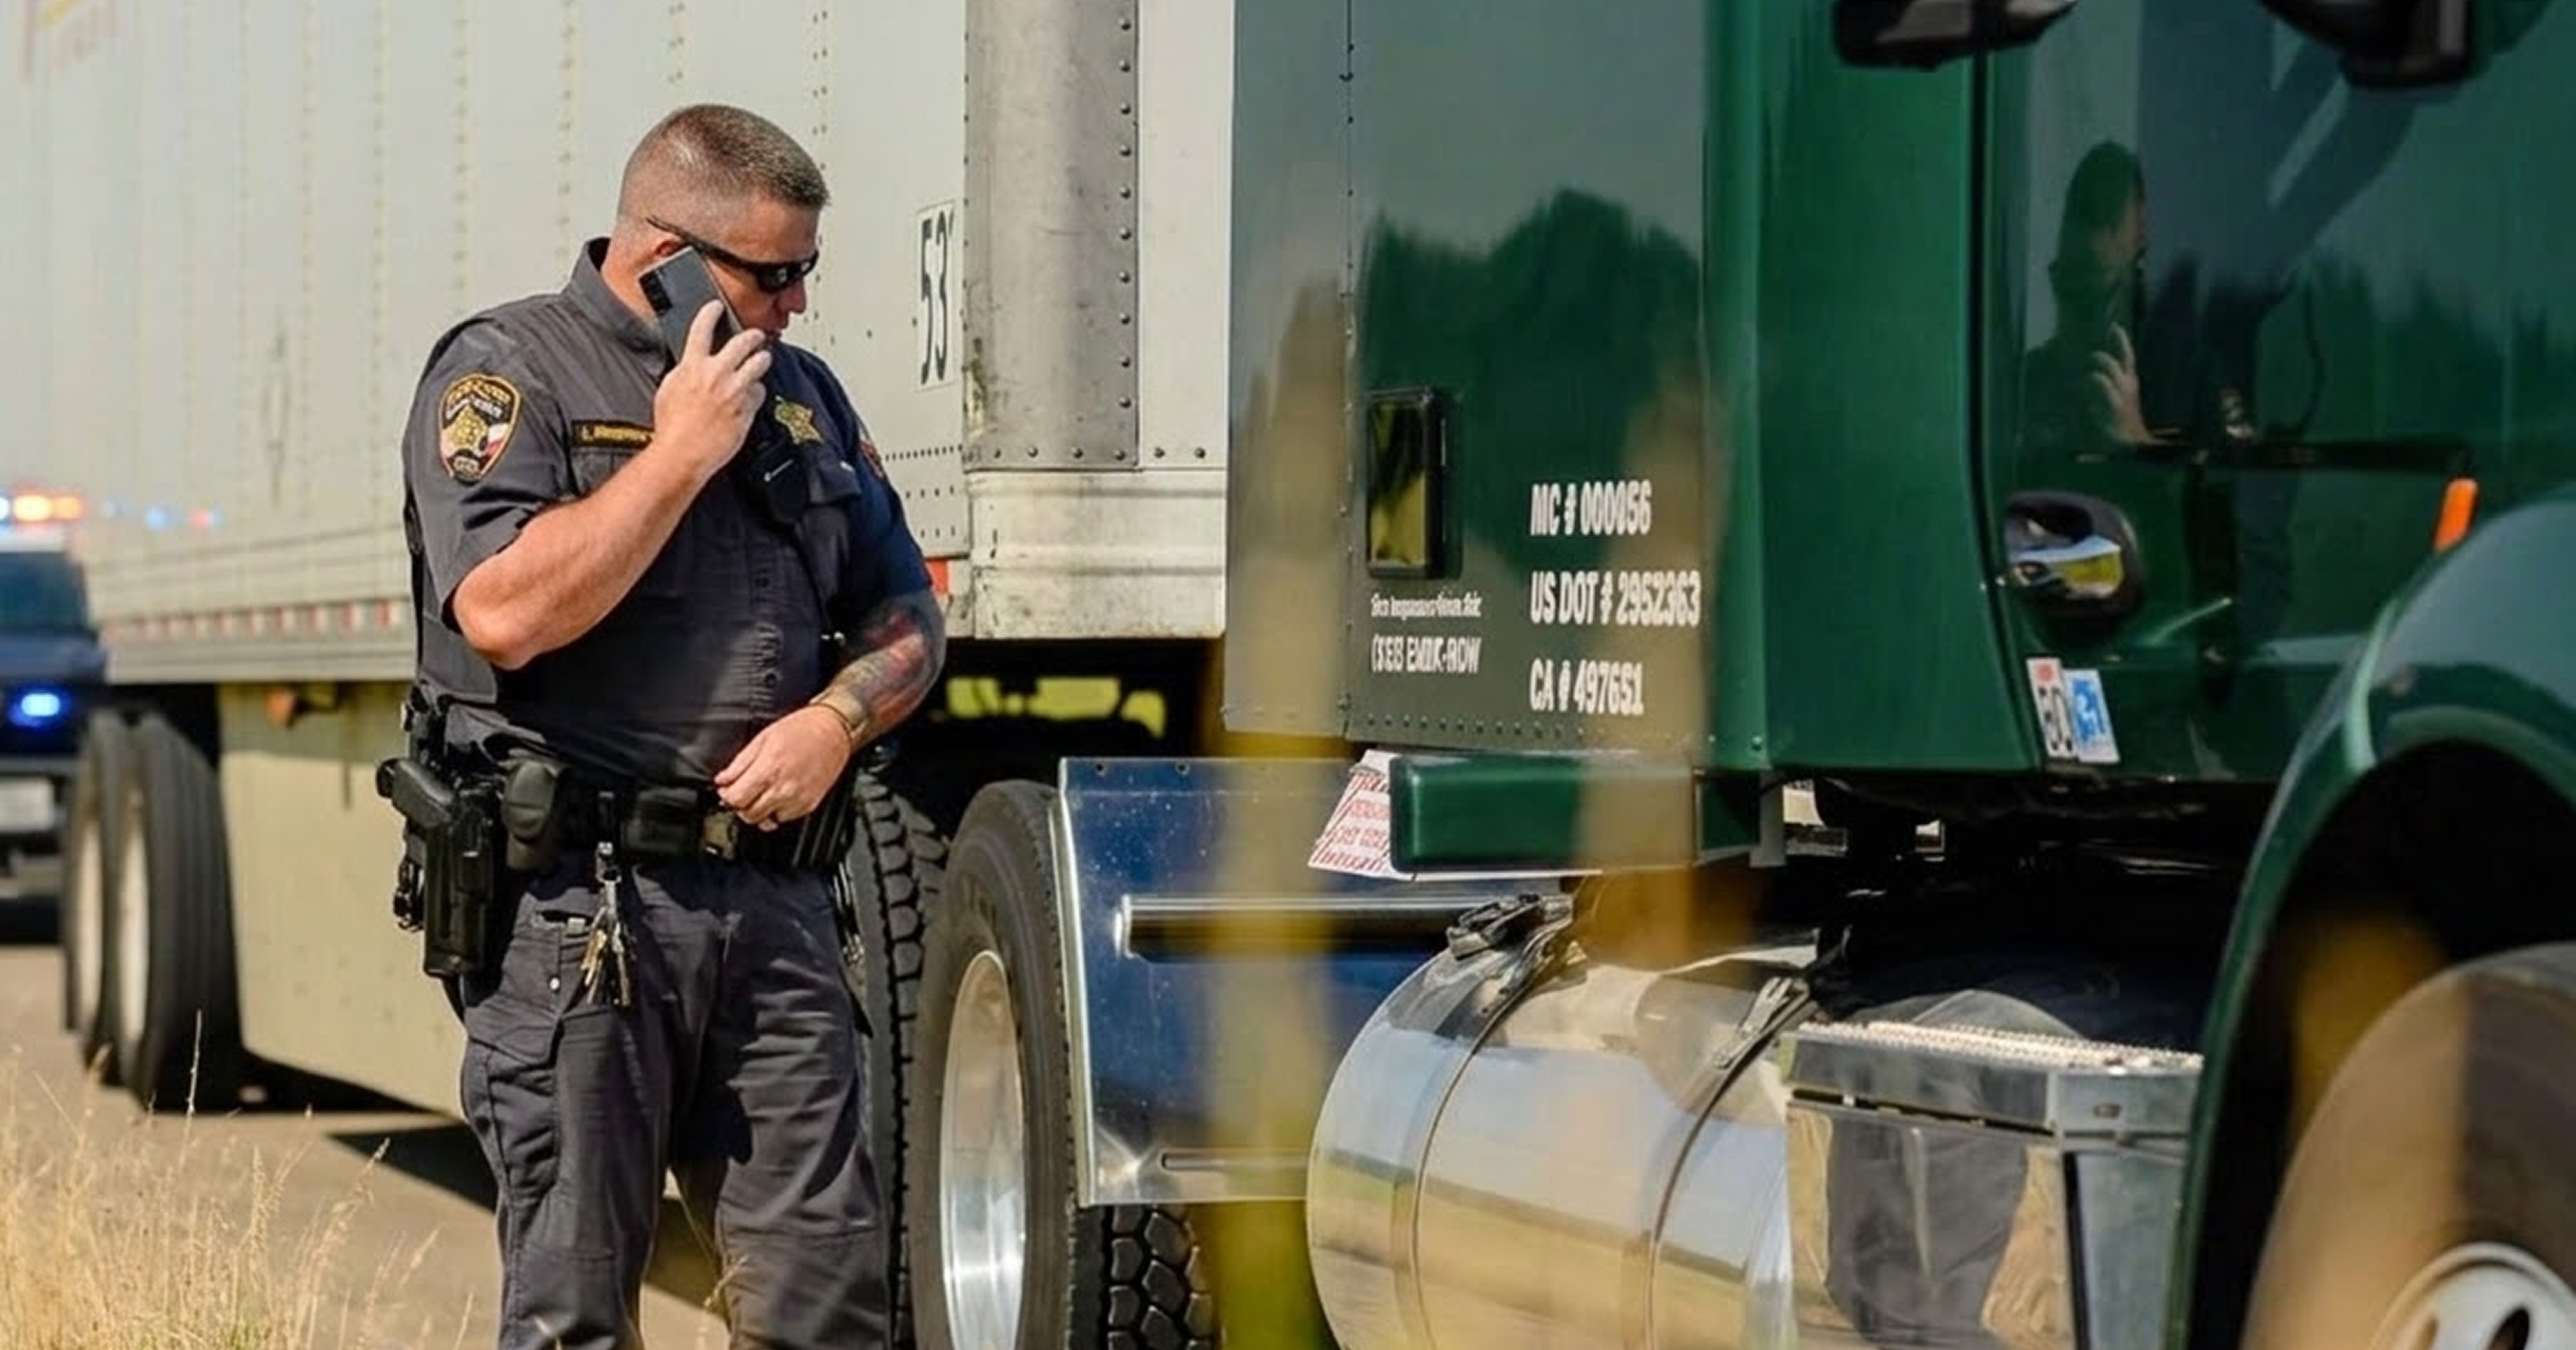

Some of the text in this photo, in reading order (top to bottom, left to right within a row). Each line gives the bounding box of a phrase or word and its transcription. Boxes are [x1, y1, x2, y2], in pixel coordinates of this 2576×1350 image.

[1531, 483, 1562, 536] MC
[1580, 480, 1652, 535] 000056
[1530, 571, 1556, 624] US
[1558, 571, 1599, 624] DOT
[1615, 570, 1702, 628] 2952363
[1530, 657, 1554, 712] CA
[1573, 659, 1644, 715] 497651
